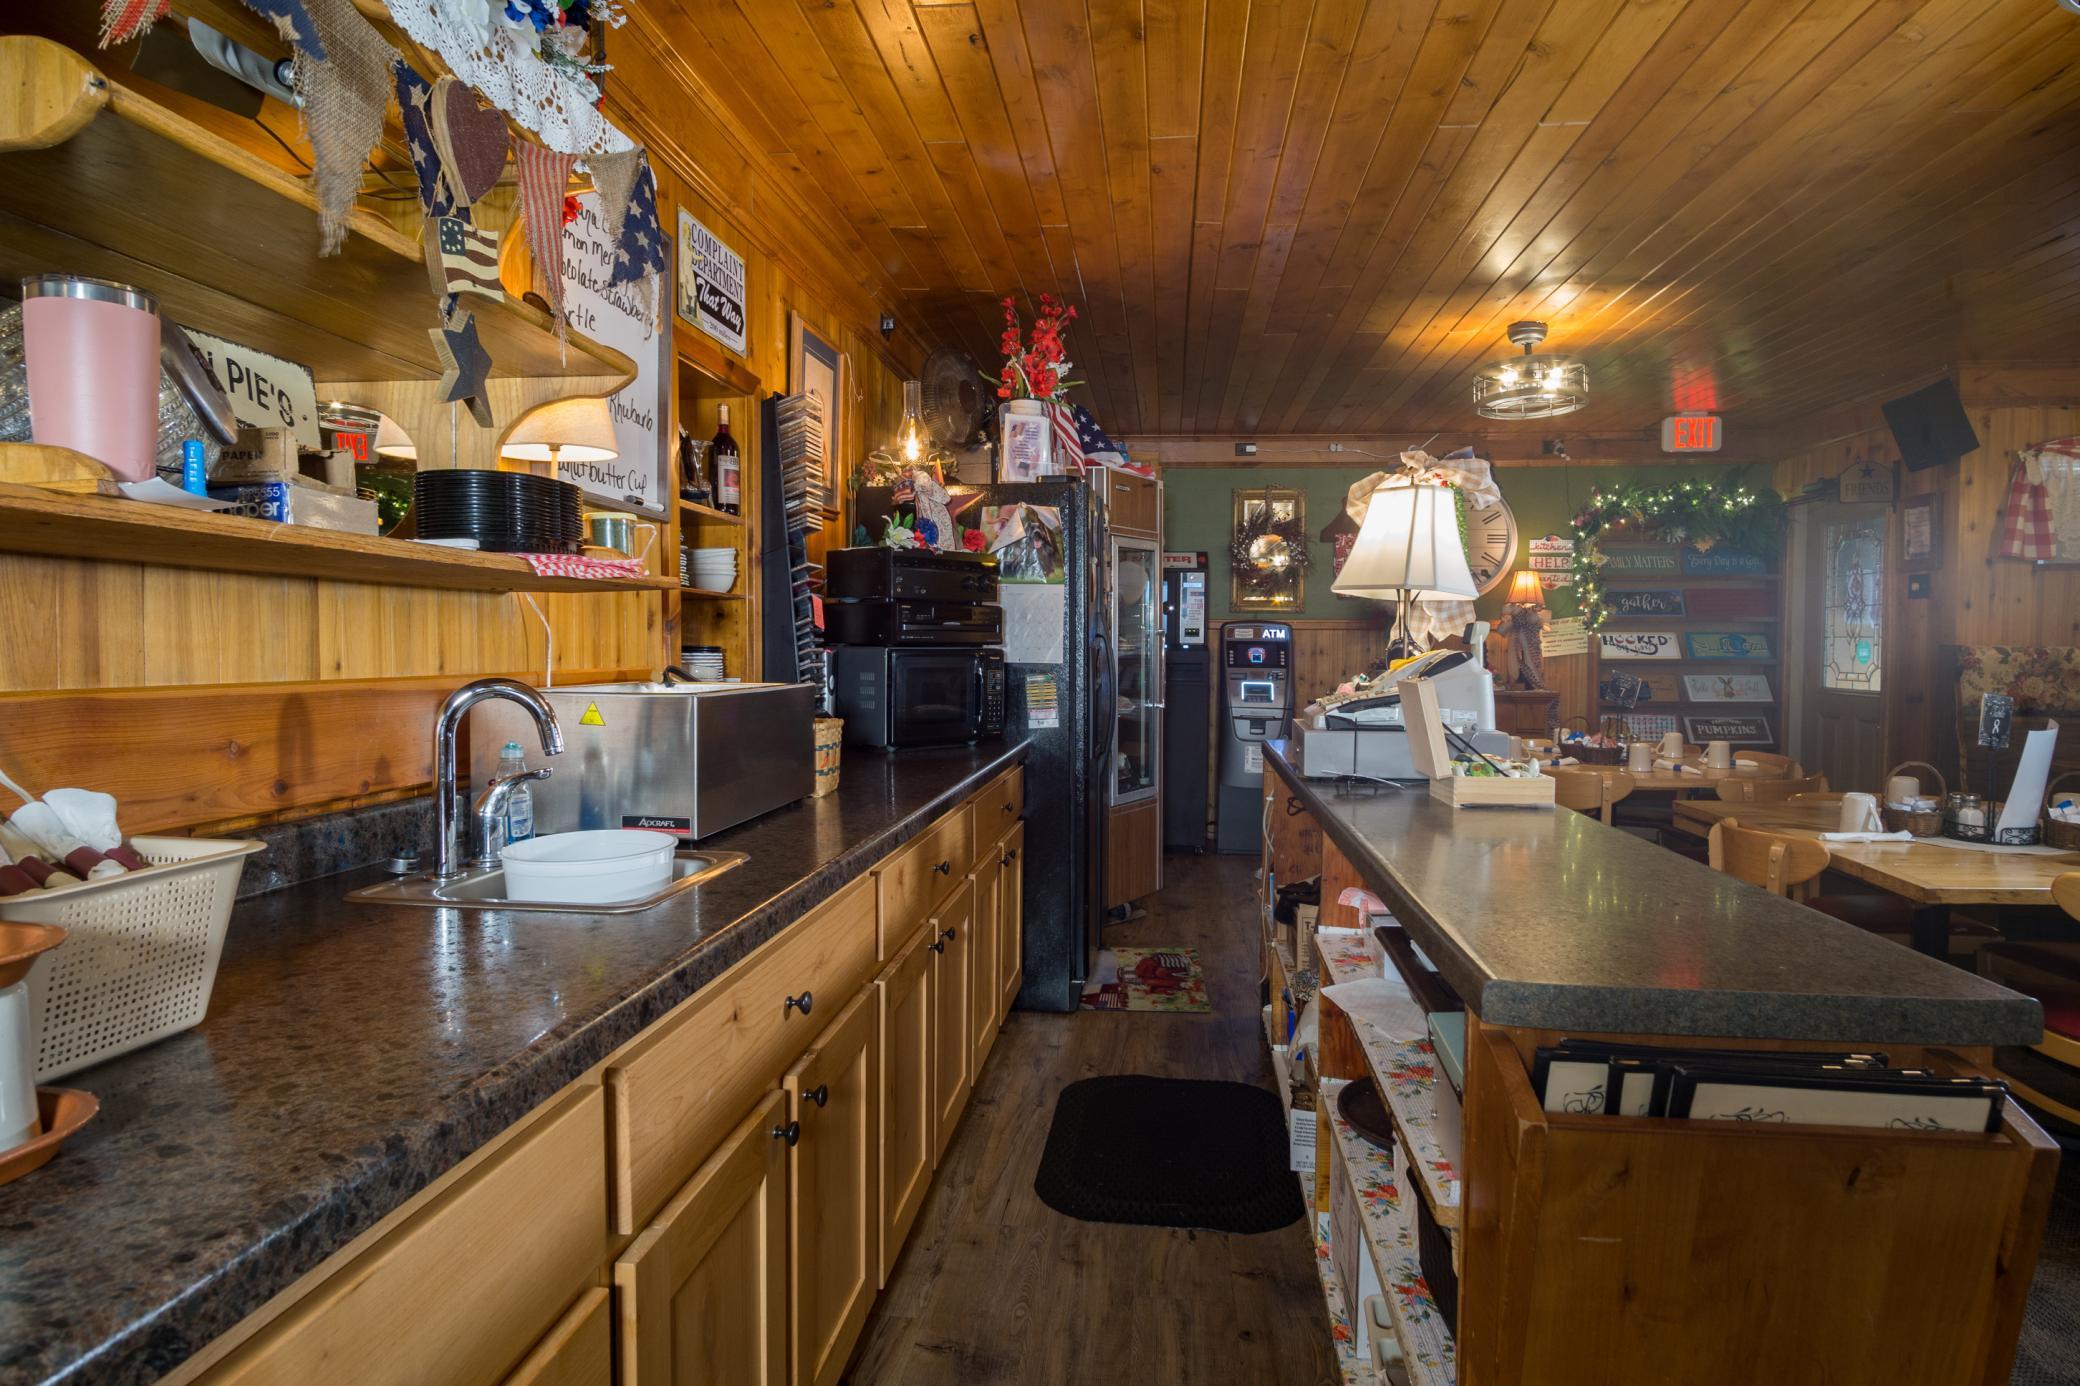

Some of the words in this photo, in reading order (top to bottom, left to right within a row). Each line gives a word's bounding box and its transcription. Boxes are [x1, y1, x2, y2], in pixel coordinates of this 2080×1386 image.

[562, 229, 589, 255] mon
[691, 223, 744, 281] COMPLAINT
[560, 258, 599, 293] ocolate
[692, 244, 744, 302] DEPARTMENT
[697, 277, 719, 312] That
[721, 296, 743, 333] Way
[565, 304, 596, 332] rtle
[226, 357, 296, 427] PIE'S
[609, 392, 653, 431] Rhubarb
[1674, 417, 1716, 448] EXIT
[221, 450, 263, 460] PAPER
[628, 470, 647, 495] Cup
[1845, 480, 1888, 496] FRIENDS
[1534, 557, 1569, 569] HELP
[1607, 555, 1632, 568] AMILY
[1633, 555, 1675, 568] MATTERS
[1621, 593, 1666, 611] gather
[1262, 629, 1286, 639] ATM
[1602, 634, 1668, 647] HOOKED
[1619, 687, 1626, 697] 7
[1697, 725, 1757, 735] PUMPKINS
